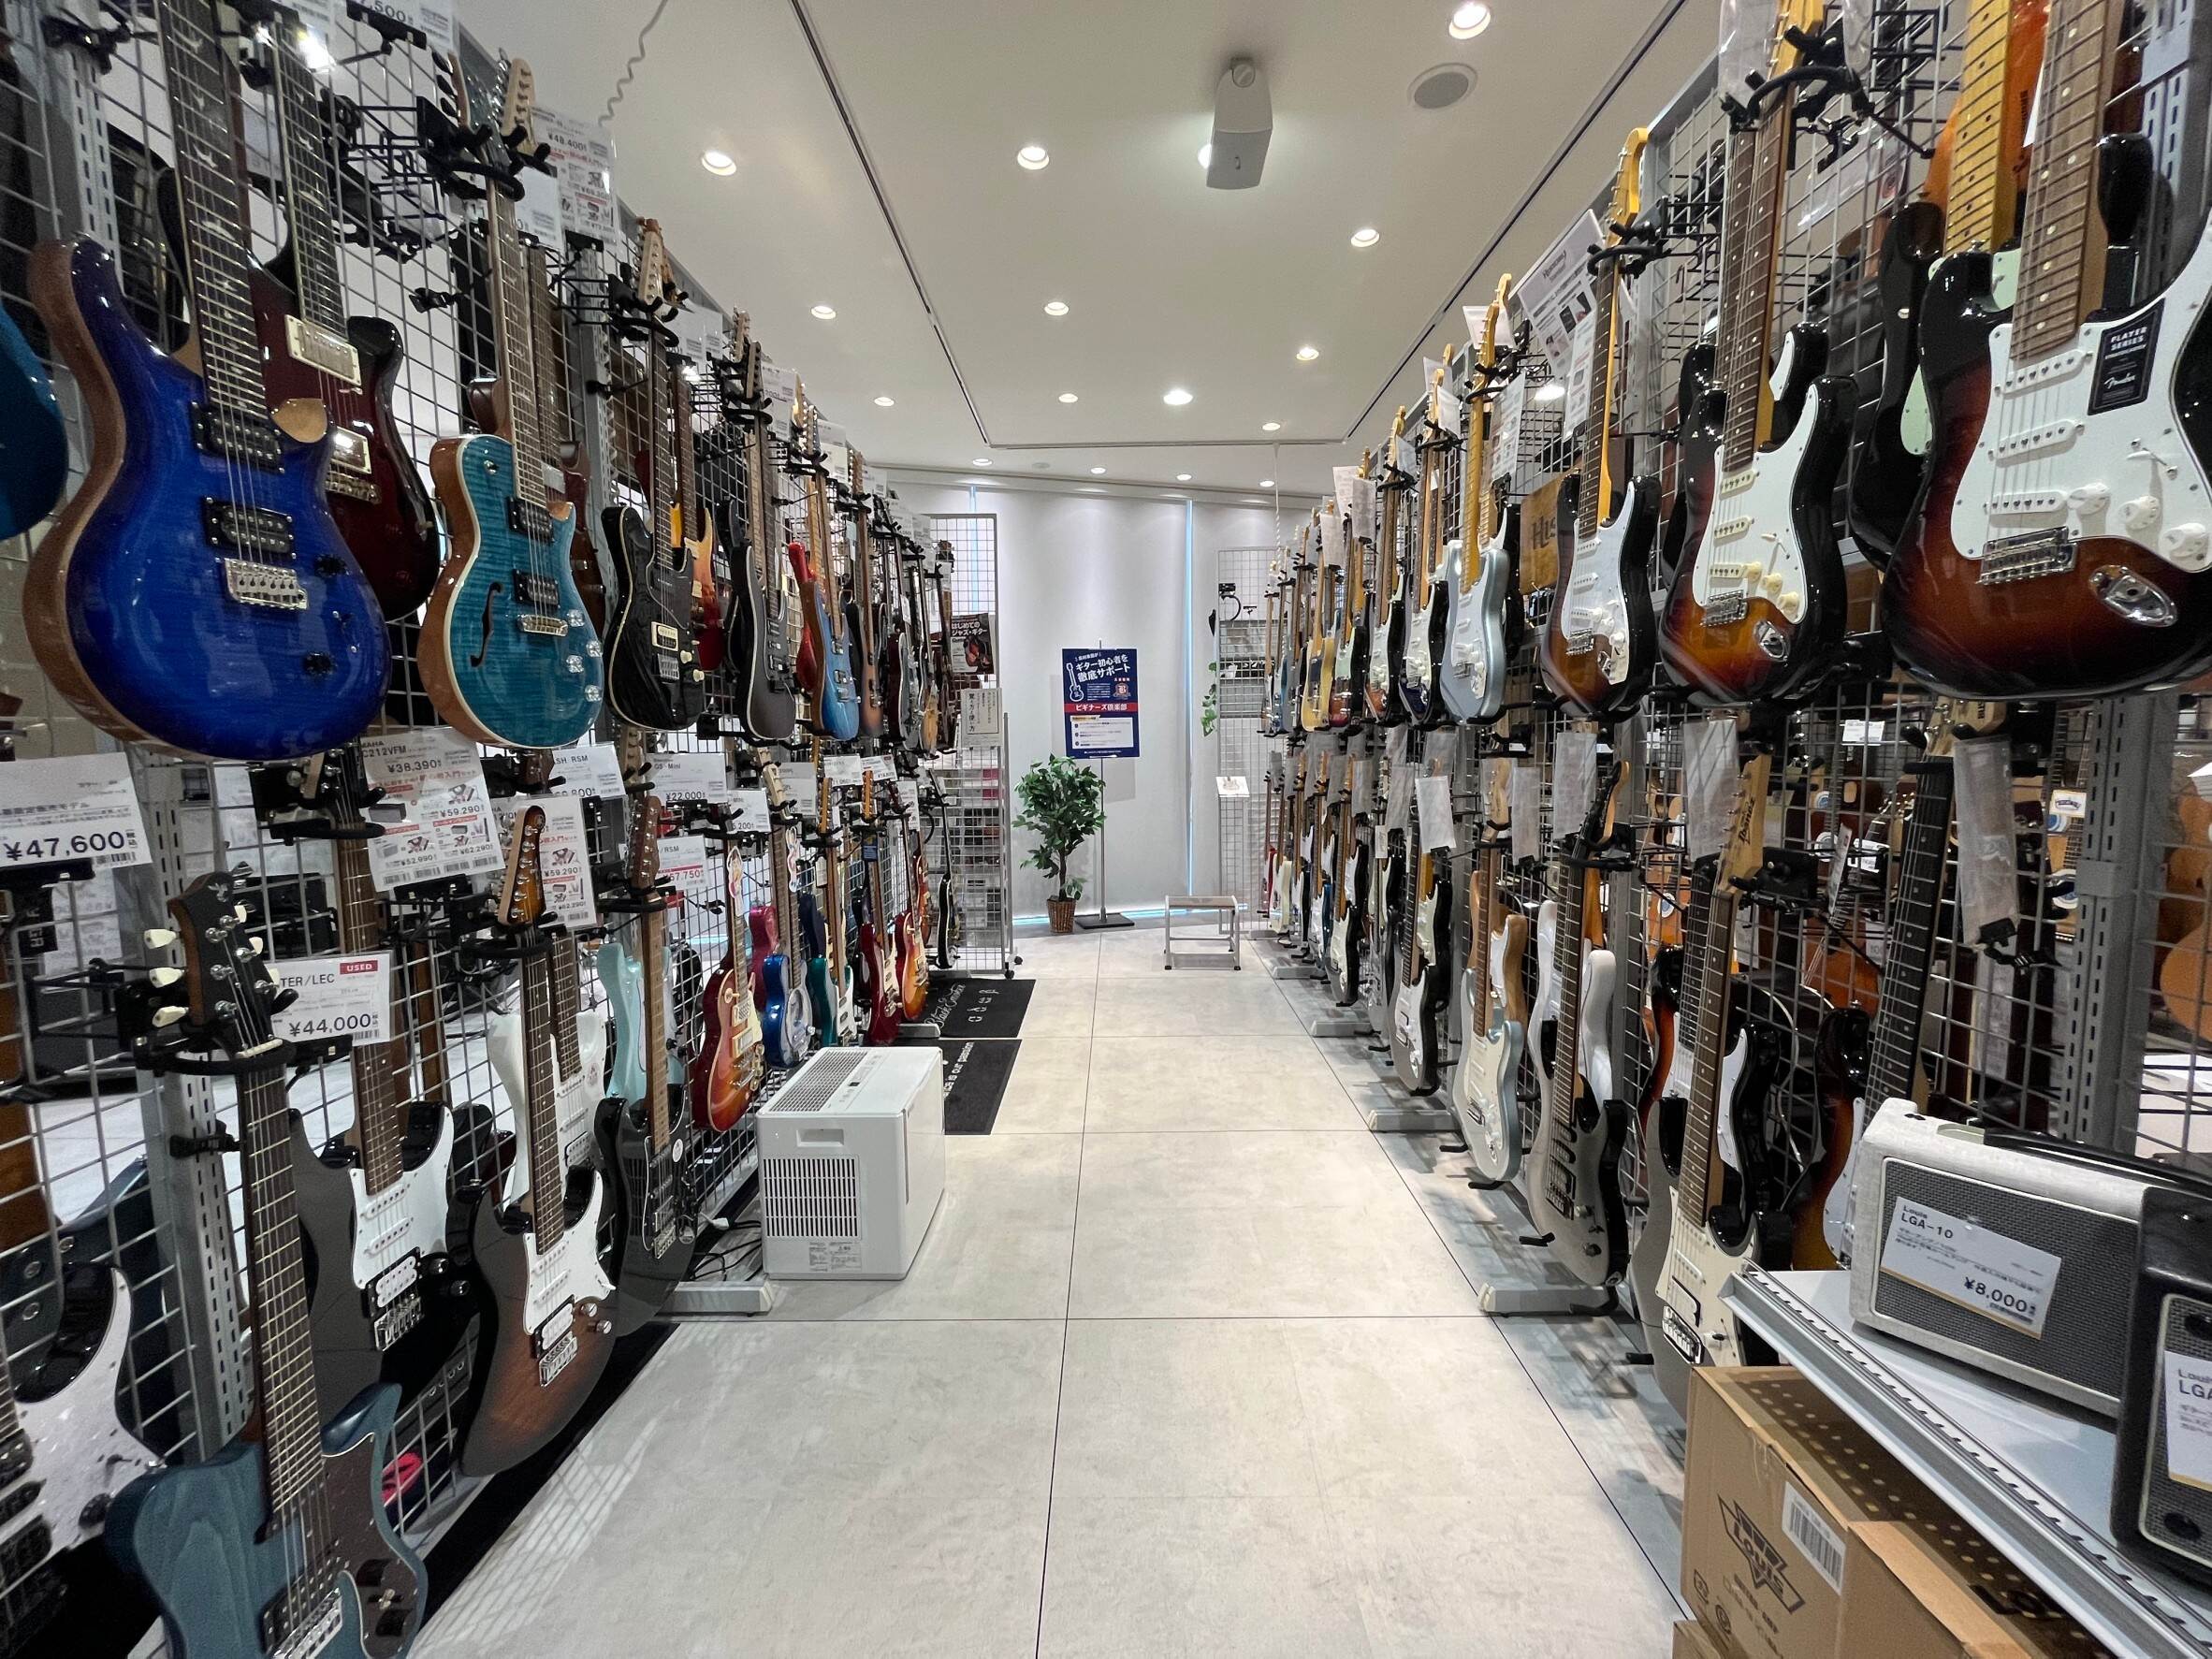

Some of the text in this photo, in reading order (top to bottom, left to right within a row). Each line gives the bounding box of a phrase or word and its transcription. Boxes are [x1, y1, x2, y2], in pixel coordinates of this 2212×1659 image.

[2111, 327, 2147, 342] PLAYER
[2111, 335, 2144, 351] SERIES
[1076, 654, 1128, 671] ギター初心者を
[1077, 663, 1130, 682] 徹底サポート
[1076, 703, 1128, 711] ビギナーズ倶楽部
[4, 831, 124, 861] ¥47,600
[346, 964, 373, 972] USED
[289, 1013, 371, 1037] ¥44,000
[1900, 1213, 1954, 1239] LGA-10
